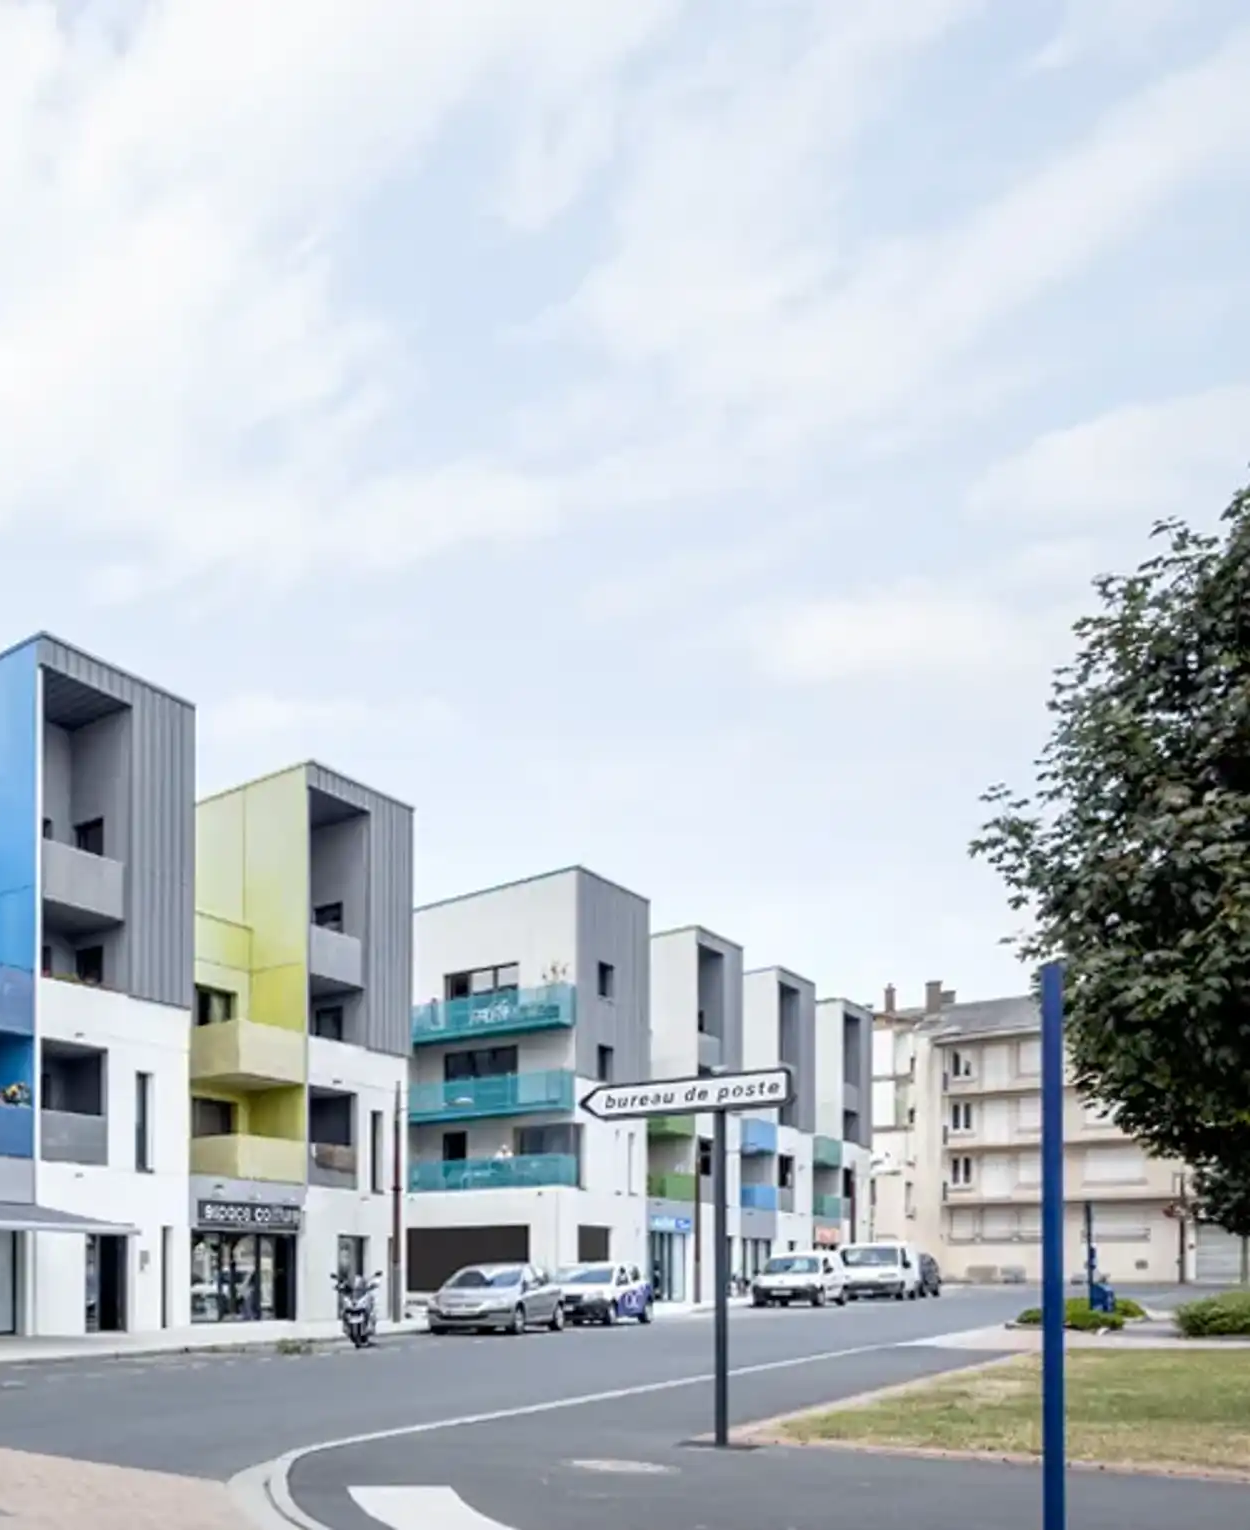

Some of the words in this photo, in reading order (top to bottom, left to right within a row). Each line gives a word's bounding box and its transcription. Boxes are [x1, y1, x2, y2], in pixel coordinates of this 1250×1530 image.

[605, 1092, 675, 1109] bureau
[684, 1085, 708, 1102] de
[716, 1081, 780, 1103] poste
